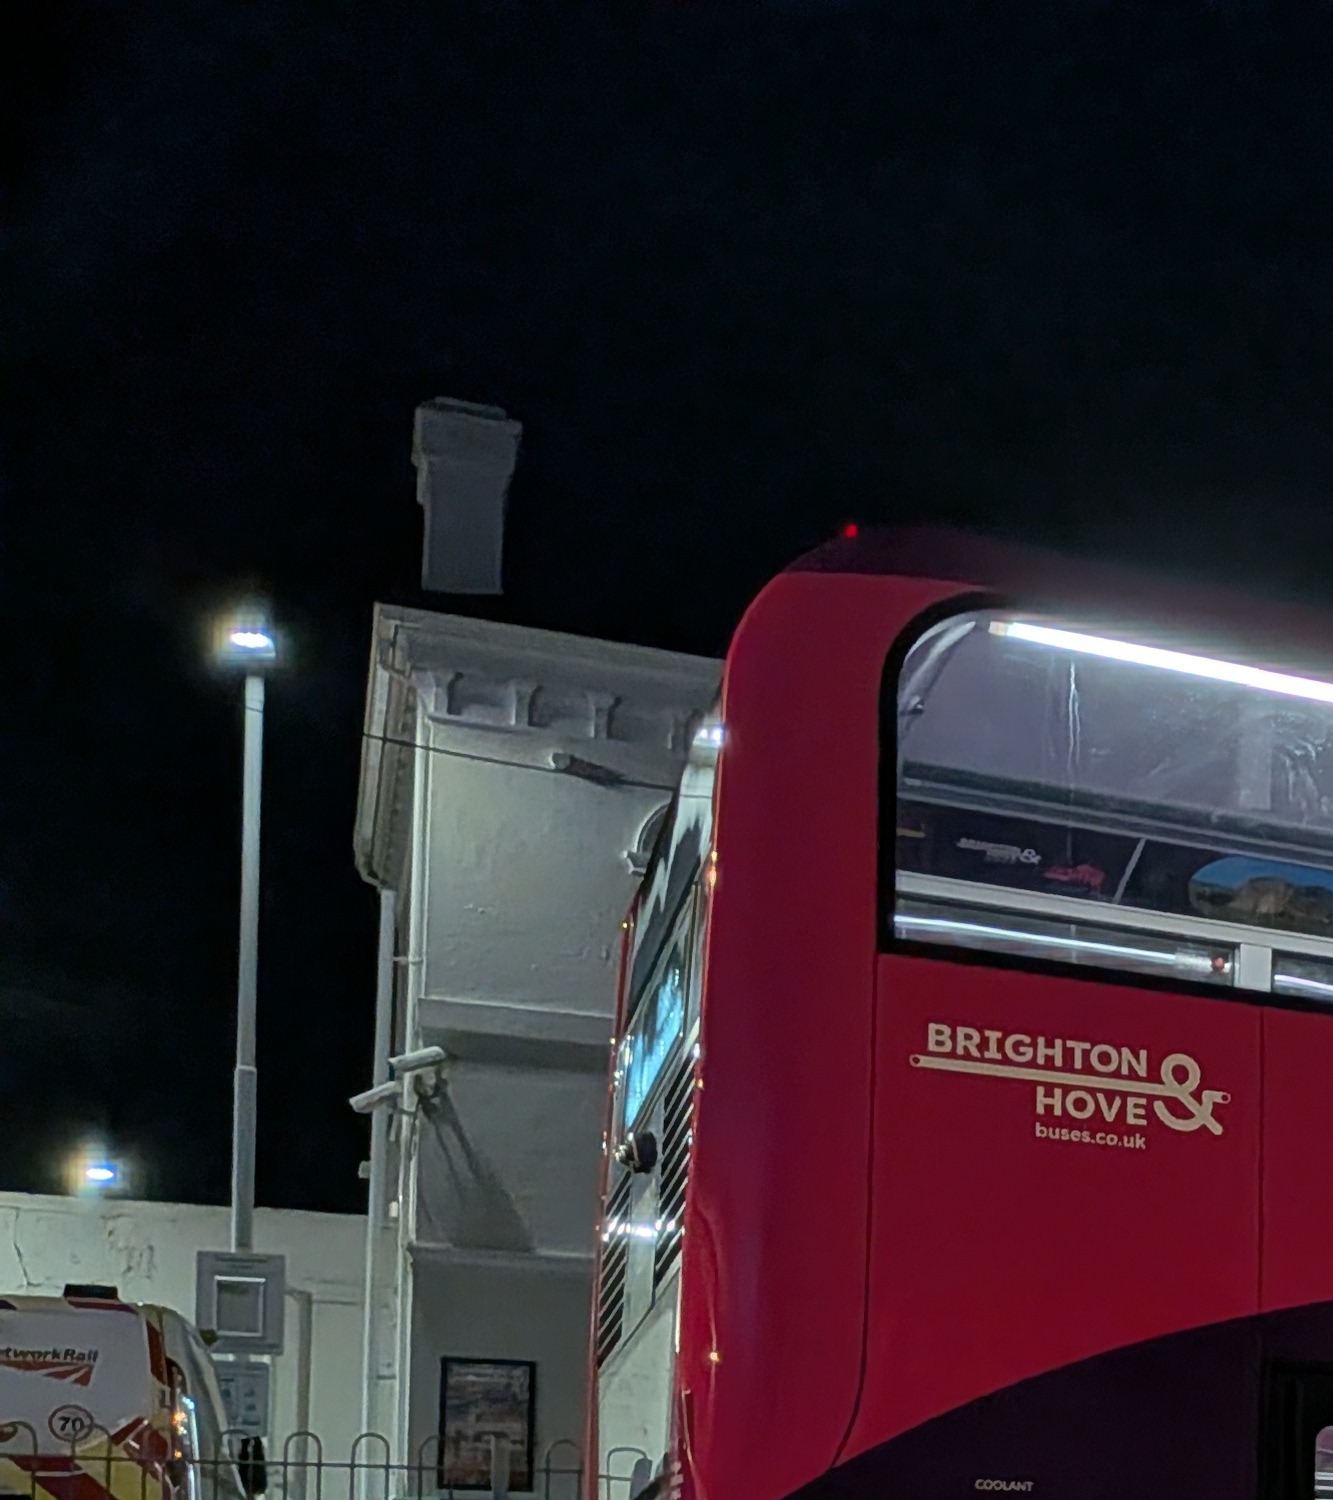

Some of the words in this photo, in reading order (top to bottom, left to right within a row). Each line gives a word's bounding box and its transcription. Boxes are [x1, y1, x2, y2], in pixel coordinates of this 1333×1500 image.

[927, 1022, 1148, 1078] BRIGHTON
[1035, 1086, 1148, 1126] HOVE
[1035, 1121, 1147, 1150] buses.co.uk
[60, 1416, 85, 1432] 70
[974, 1479, 1034, 1492] COOLANT
